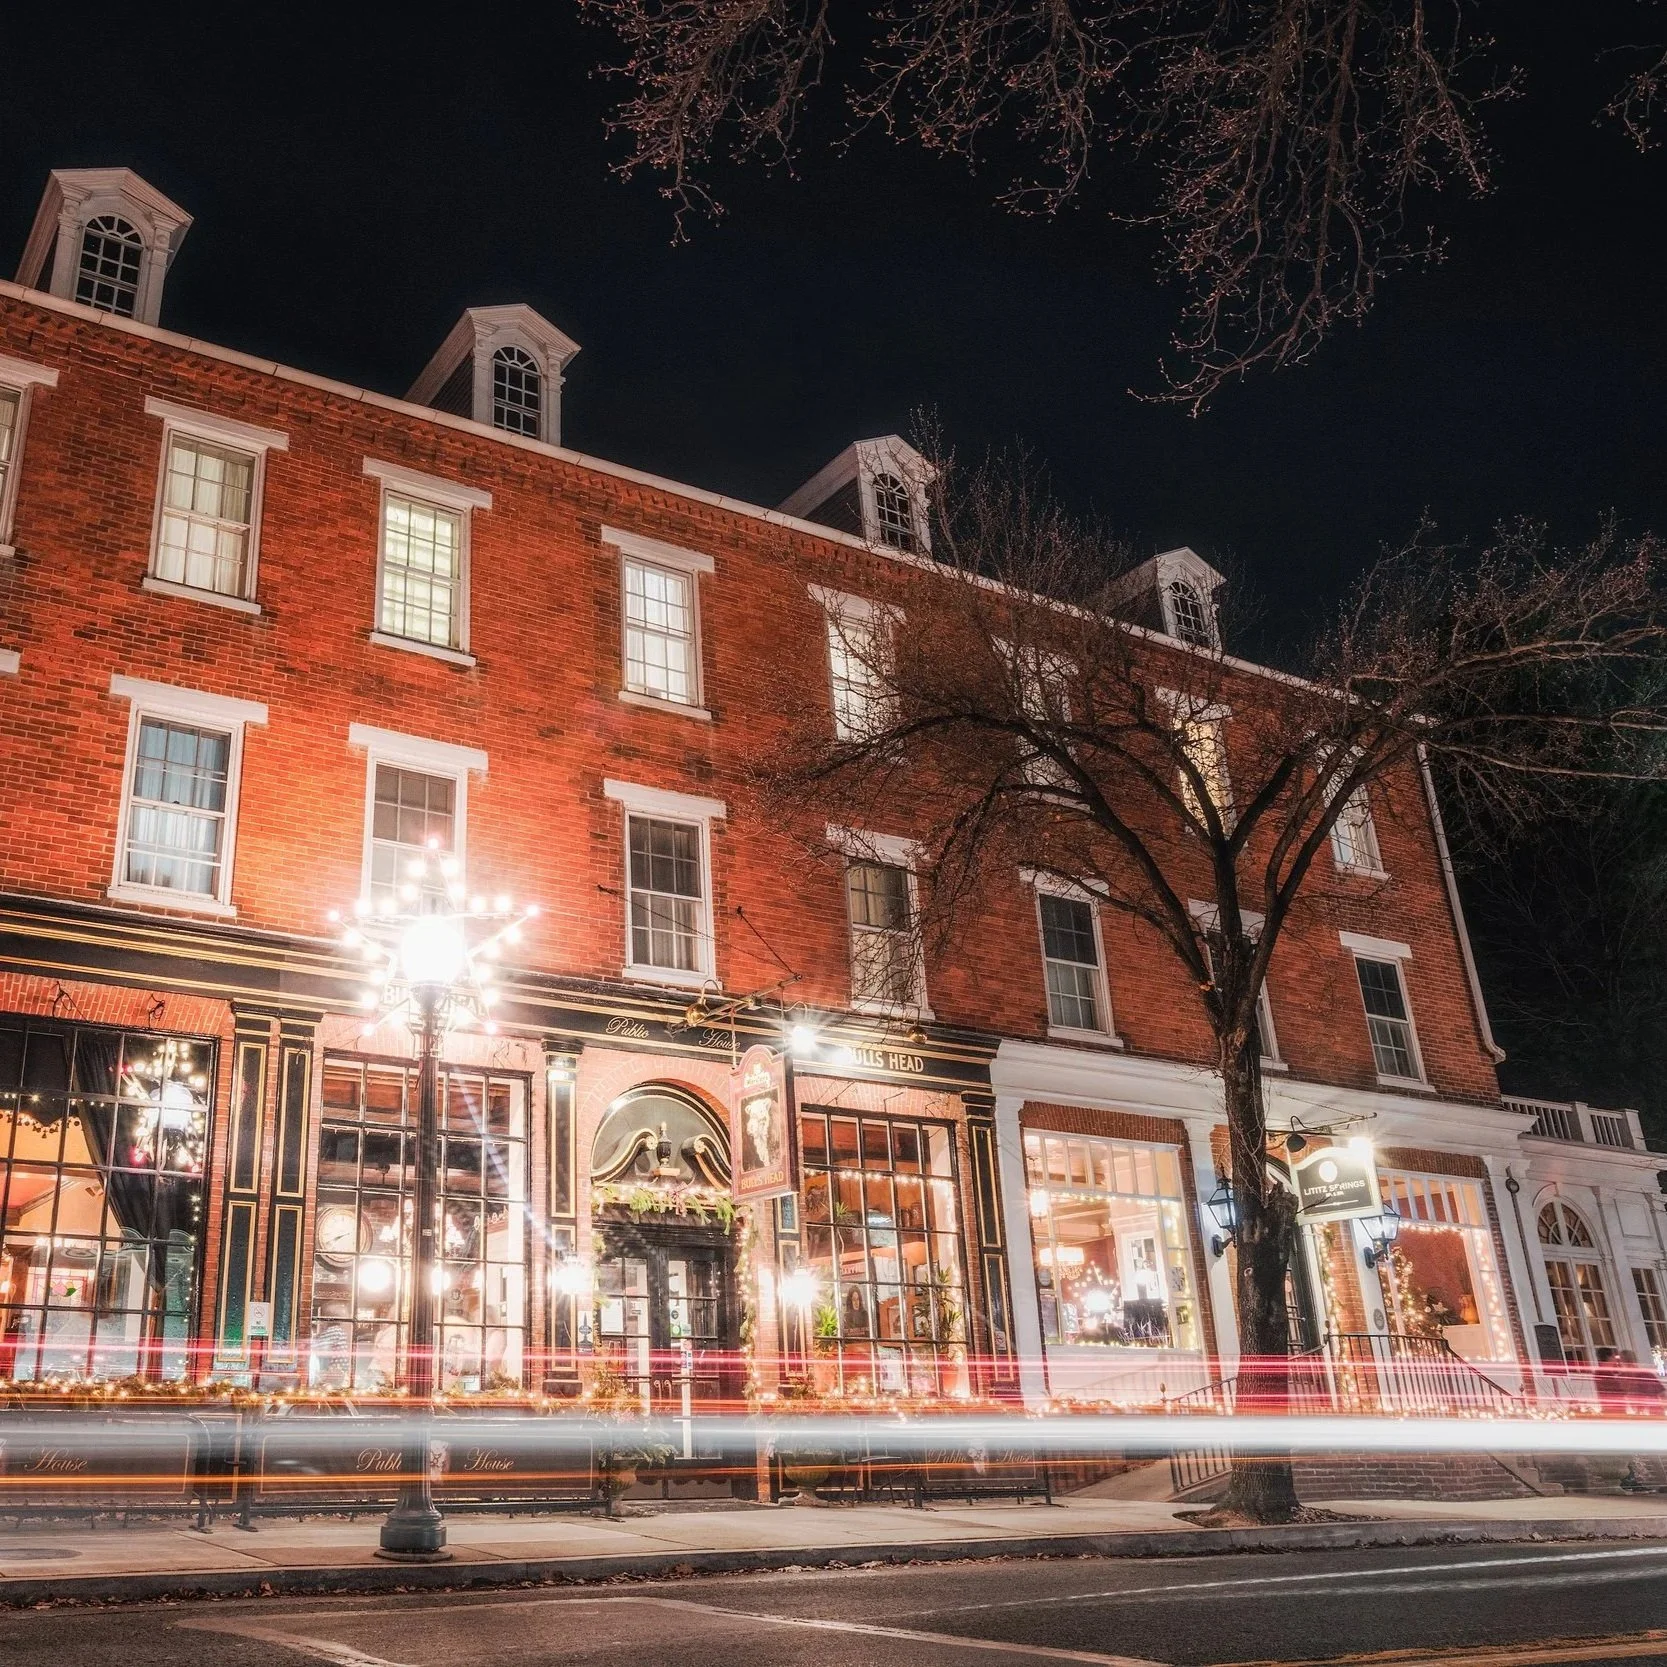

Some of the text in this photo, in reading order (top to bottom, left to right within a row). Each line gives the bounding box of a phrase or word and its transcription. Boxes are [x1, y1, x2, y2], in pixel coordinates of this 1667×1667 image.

[605, 1016, 742, 1050] Public House
[889, 1053, 924, 1073] HEAD
[764, 1170, 784, 1185] HEAD
[1303, 1185, 1328, 1196] LITITZ
[1328, 1179, 1366, 1192] SPRINGS
[24, 1447, 88, 1472] House
[463, 1446, 515, 1472] House
